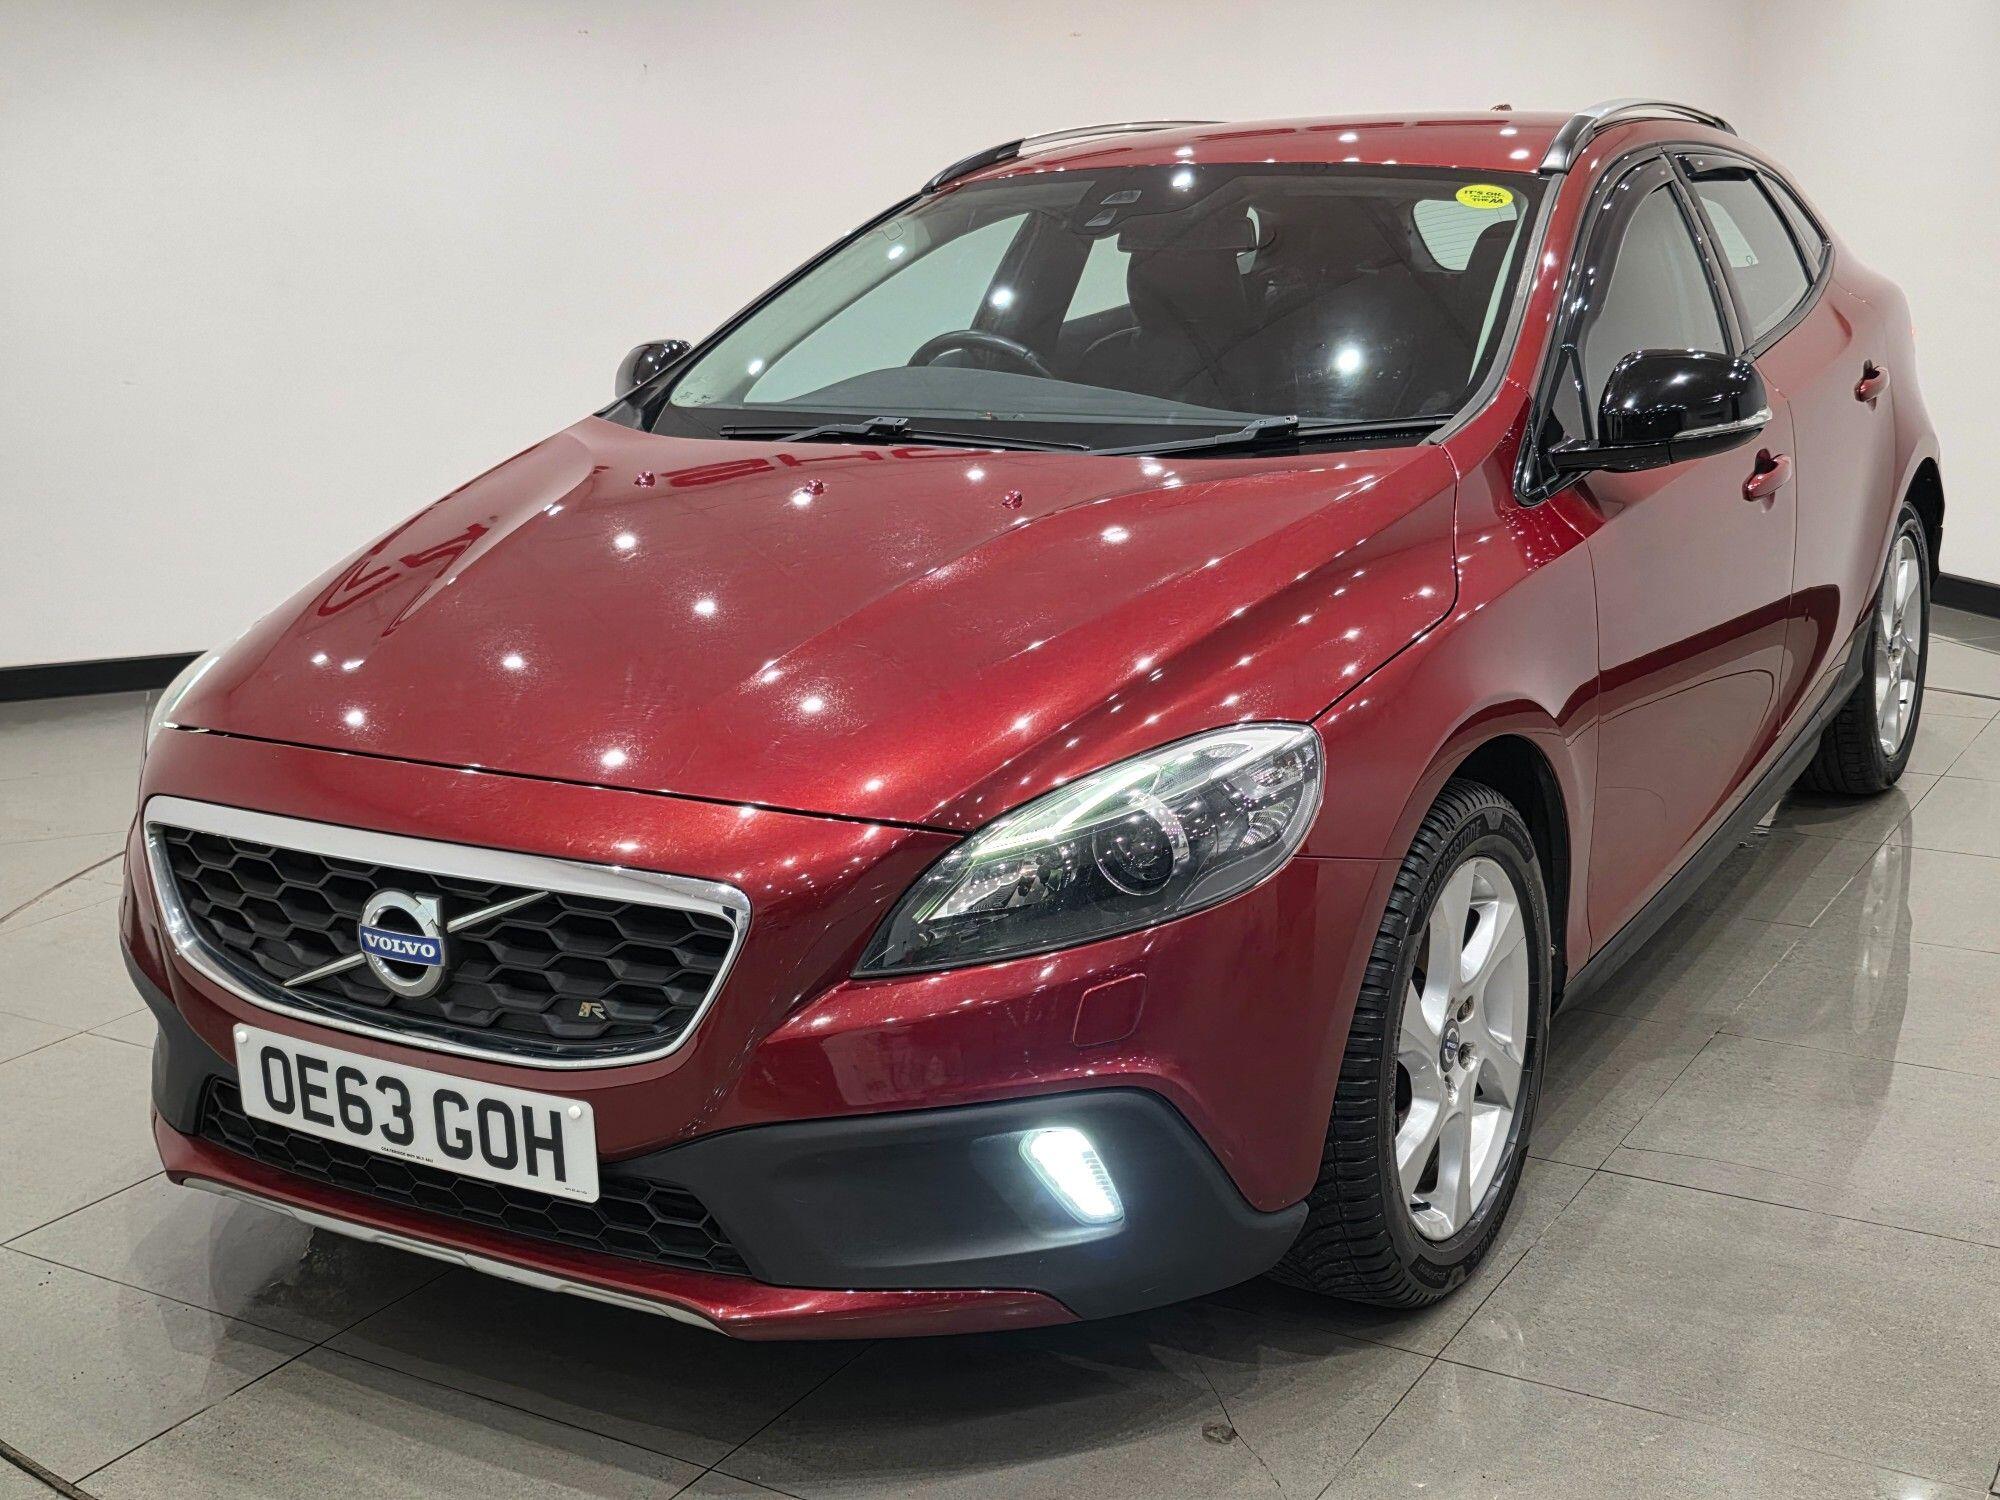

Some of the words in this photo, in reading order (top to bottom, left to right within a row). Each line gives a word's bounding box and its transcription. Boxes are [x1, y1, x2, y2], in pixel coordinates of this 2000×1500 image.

[363, 932, 436, 958] VOLVO
[260, 1045, 415, 1147] OE63
[432, 1088, 567, 1183] GOH
